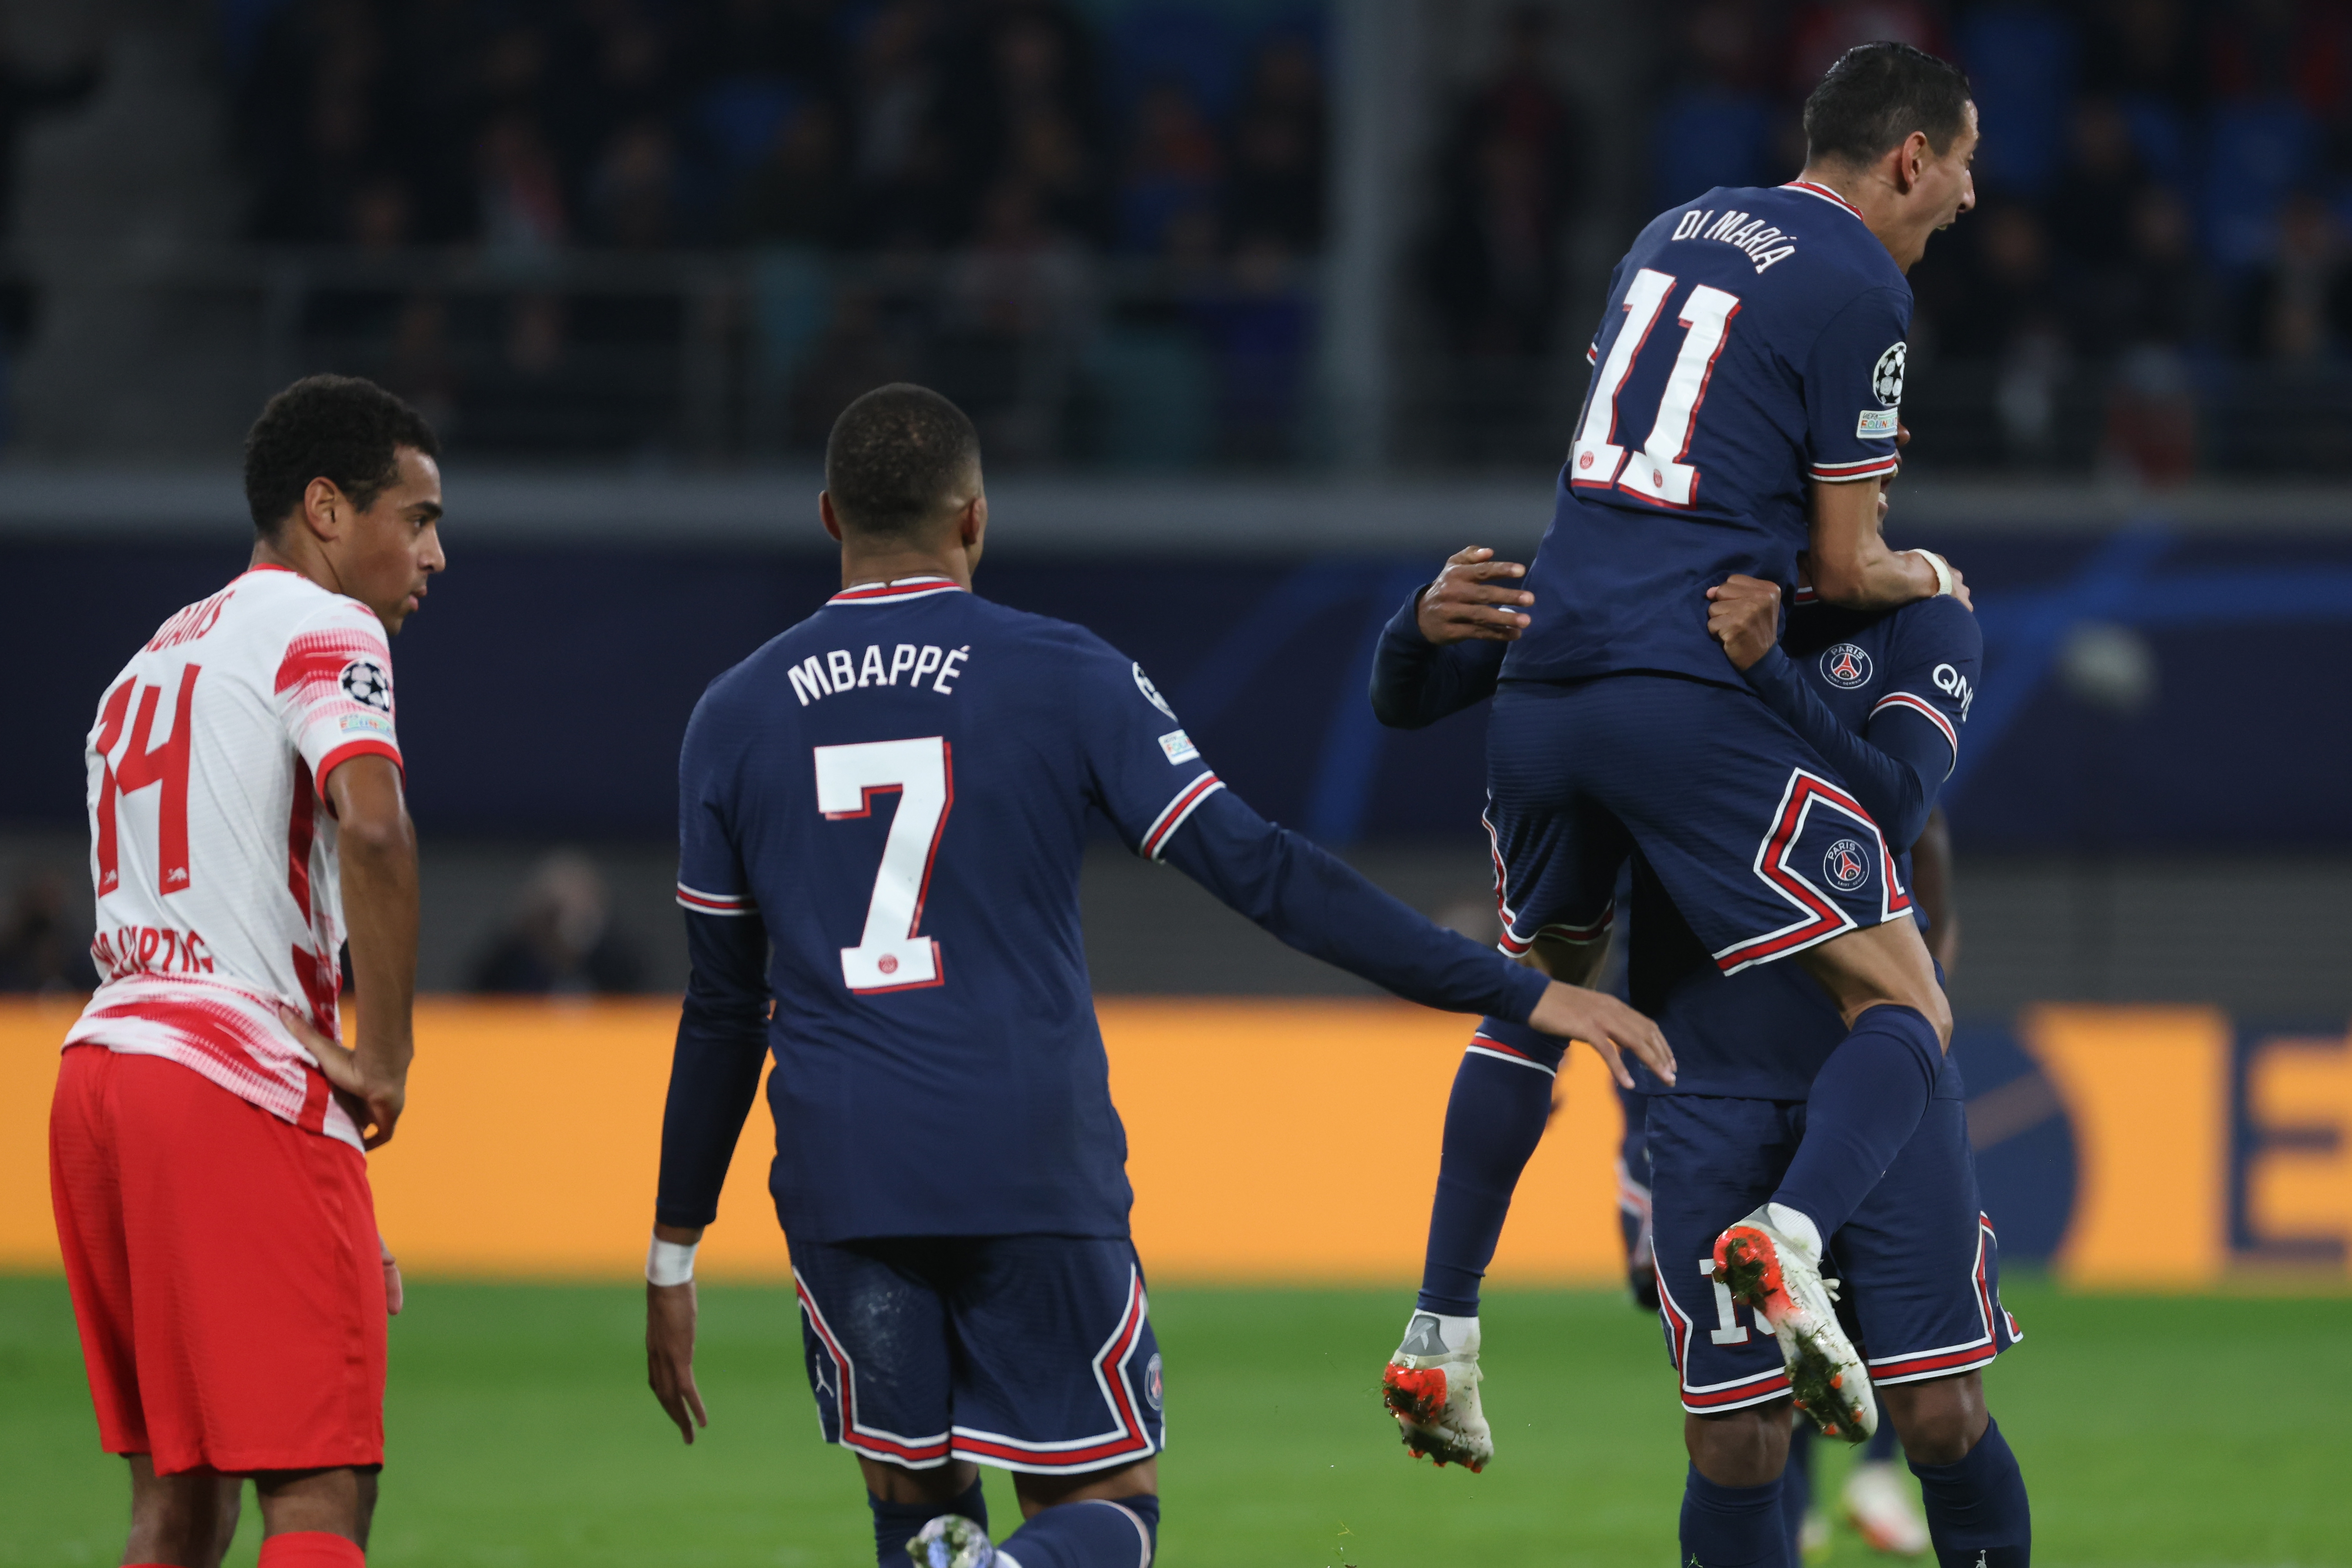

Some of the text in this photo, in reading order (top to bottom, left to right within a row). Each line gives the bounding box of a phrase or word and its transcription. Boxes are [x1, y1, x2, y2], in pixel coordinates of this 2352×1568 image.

[1672, 210, 1797, 274] DI MARÍA
[1571, 268, 1742, 510] 11
[787, 644, 970, 706] MBAPPÉ
[1831, 646, 1865, 660] PARIS
[95, 663, 202, 899] 14
[814, 736, 954, 994] 7
[1828, 841, 1856, 860] PARIS
